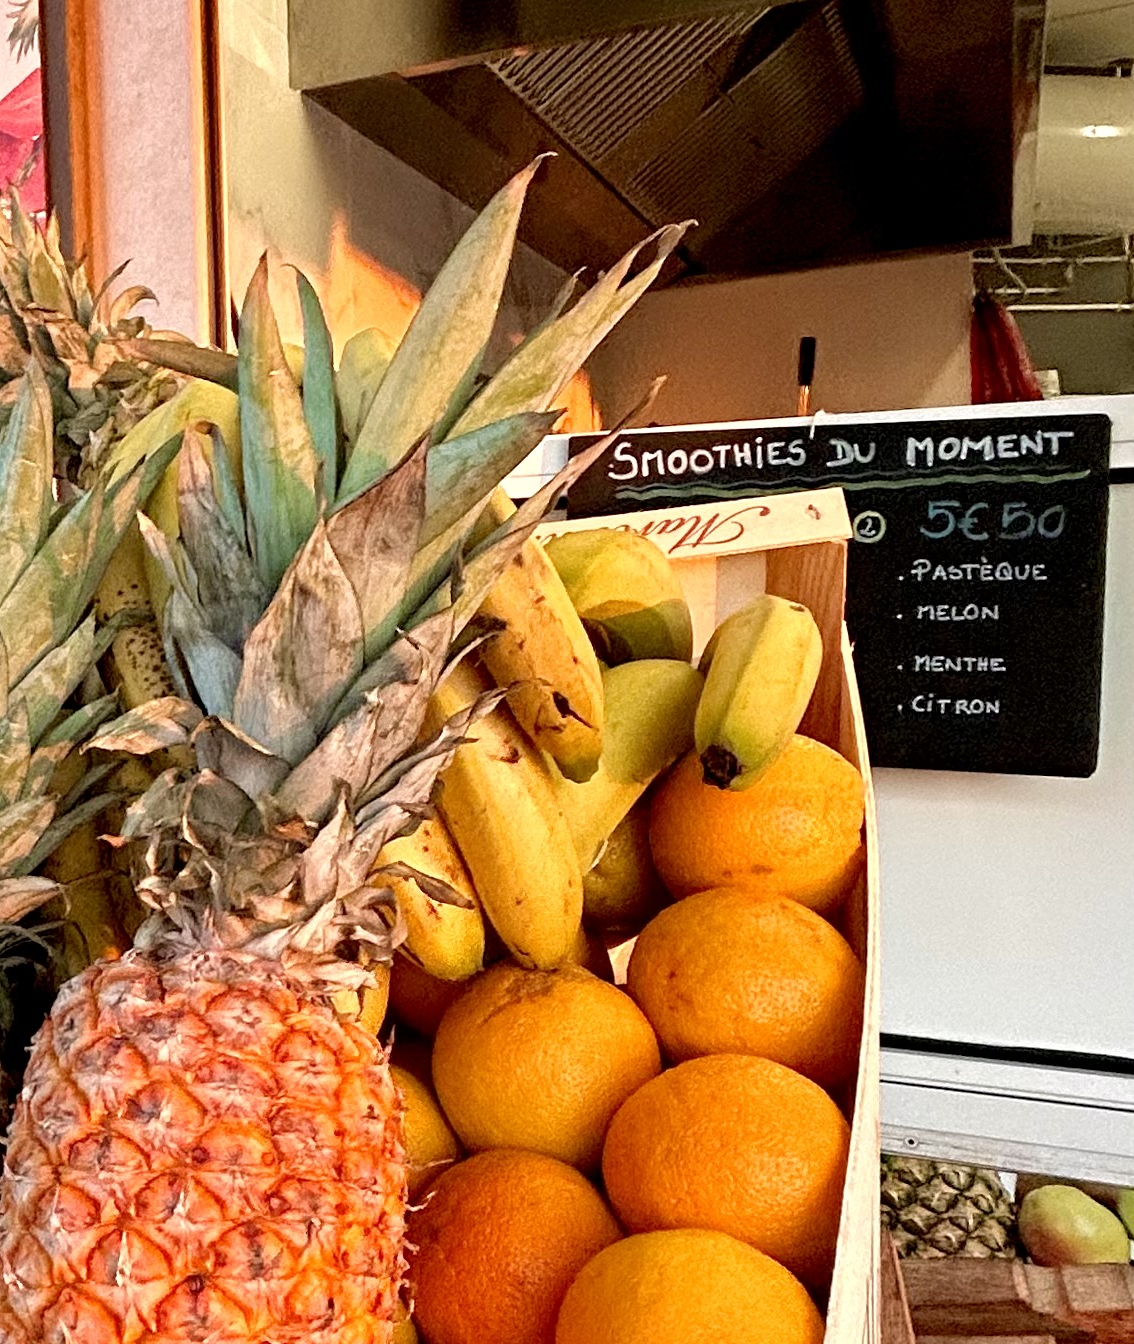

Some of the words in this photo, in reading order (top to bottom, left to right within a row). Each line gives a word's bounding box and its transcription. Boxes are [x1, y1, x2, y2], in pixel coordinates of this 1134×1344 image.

[825, 440, 876, 467] DU
[906, 429, 1075, 467] MOMENT
[920, 499, 1065, 541] 5€50
[911, 555, 1048, 581] PASTÈQUE
[916, 602, 1000, 623] MELON
[913, 652, 1007, 674] MENTHE
